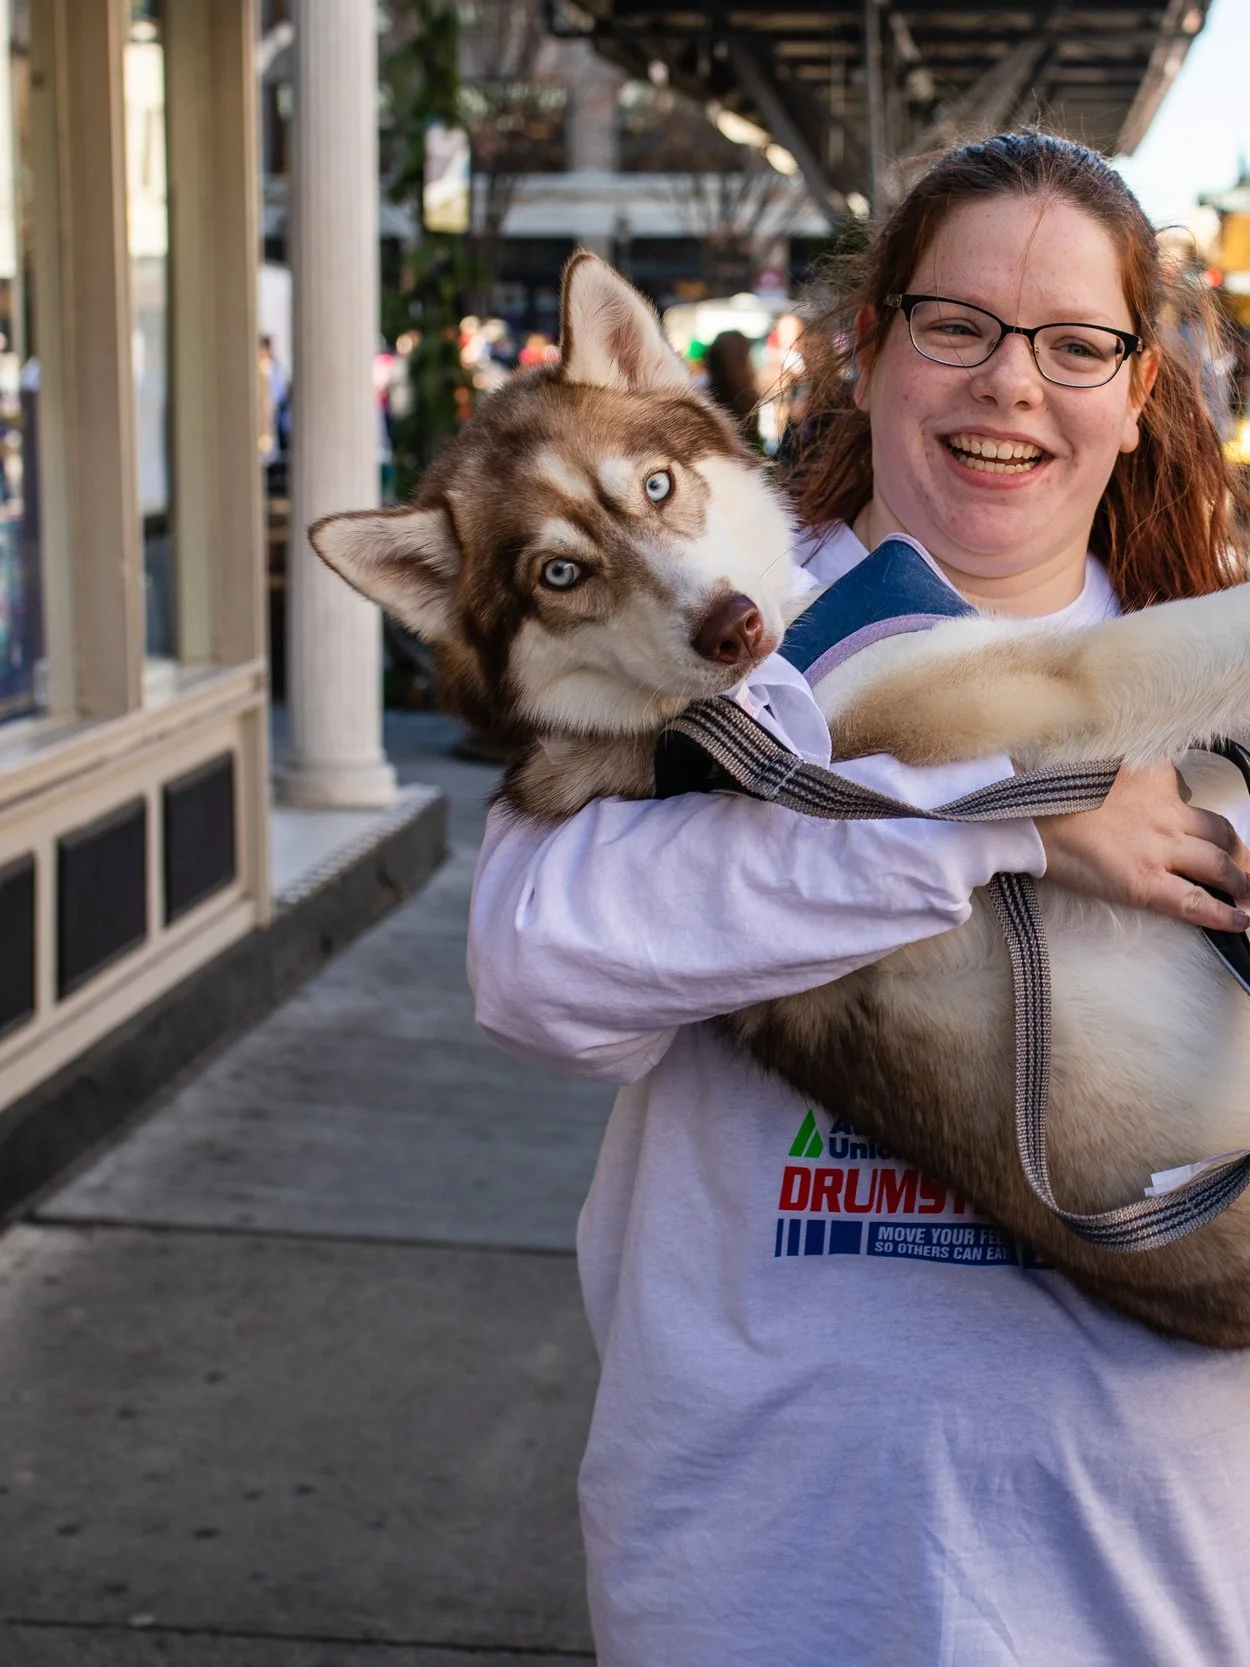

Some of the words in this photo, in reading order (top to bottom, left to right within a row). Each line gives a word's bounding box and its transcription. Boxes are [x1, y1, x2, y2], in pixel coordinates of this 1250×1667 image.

[878, 1226, 926, 1244] MOVE
[932, 1228, 975, 1246] YOUR
[874, 1241, 892, 1252] SO
[897, 1243, 950, 1259] OTHERS
[953, 1246, 983, 1261] CAN
